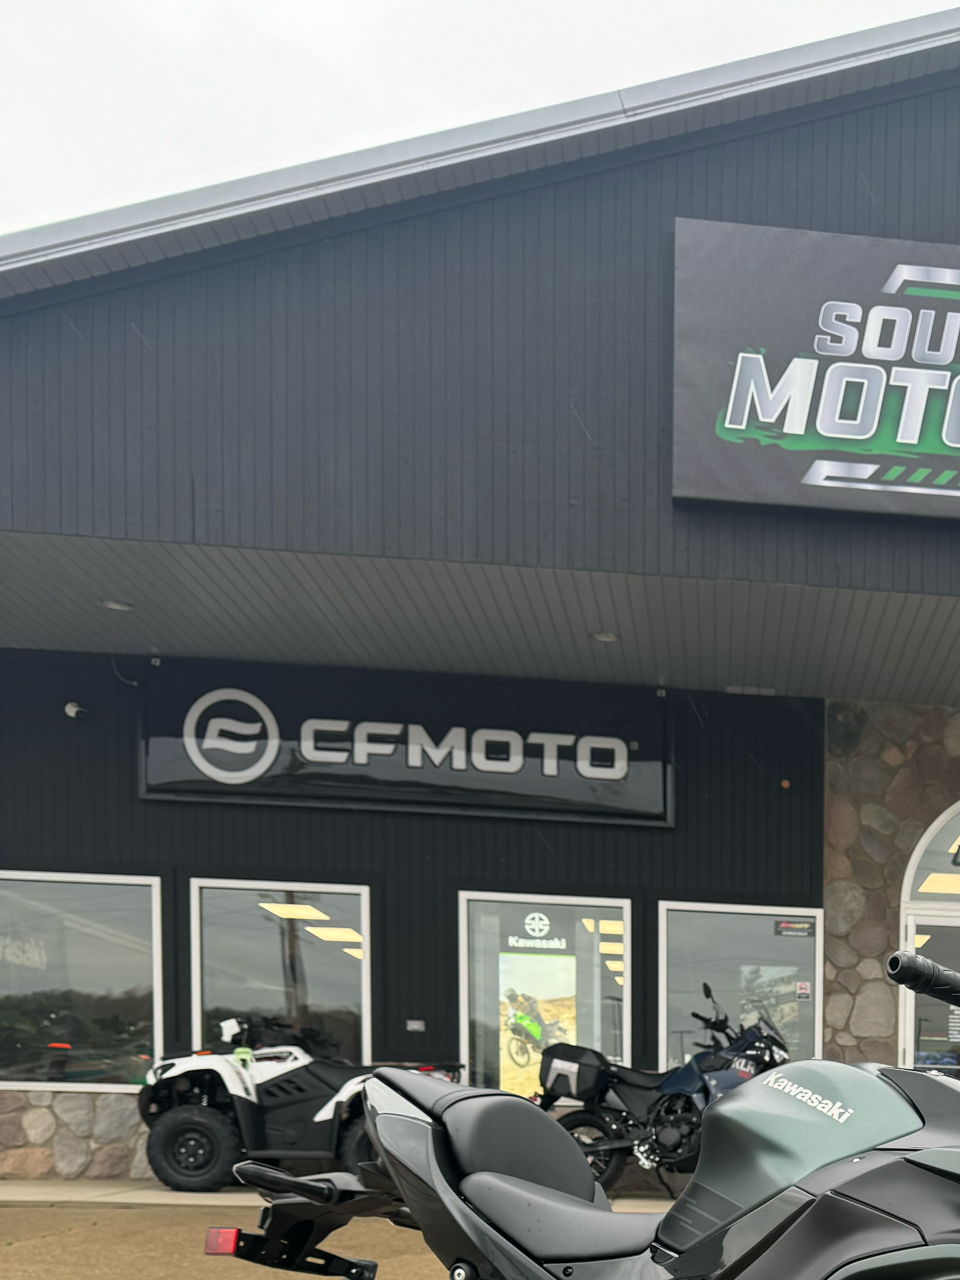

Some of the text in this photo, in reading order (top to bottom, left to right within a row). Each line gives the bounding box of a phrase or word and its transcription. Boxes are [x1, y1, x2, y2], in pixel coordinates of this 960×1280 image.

[299, 718, 629, 781] CFMOTO
[508, 935, 567, 950] Kawasaki
[762, 1071, 855, 1124] Kawasaki
